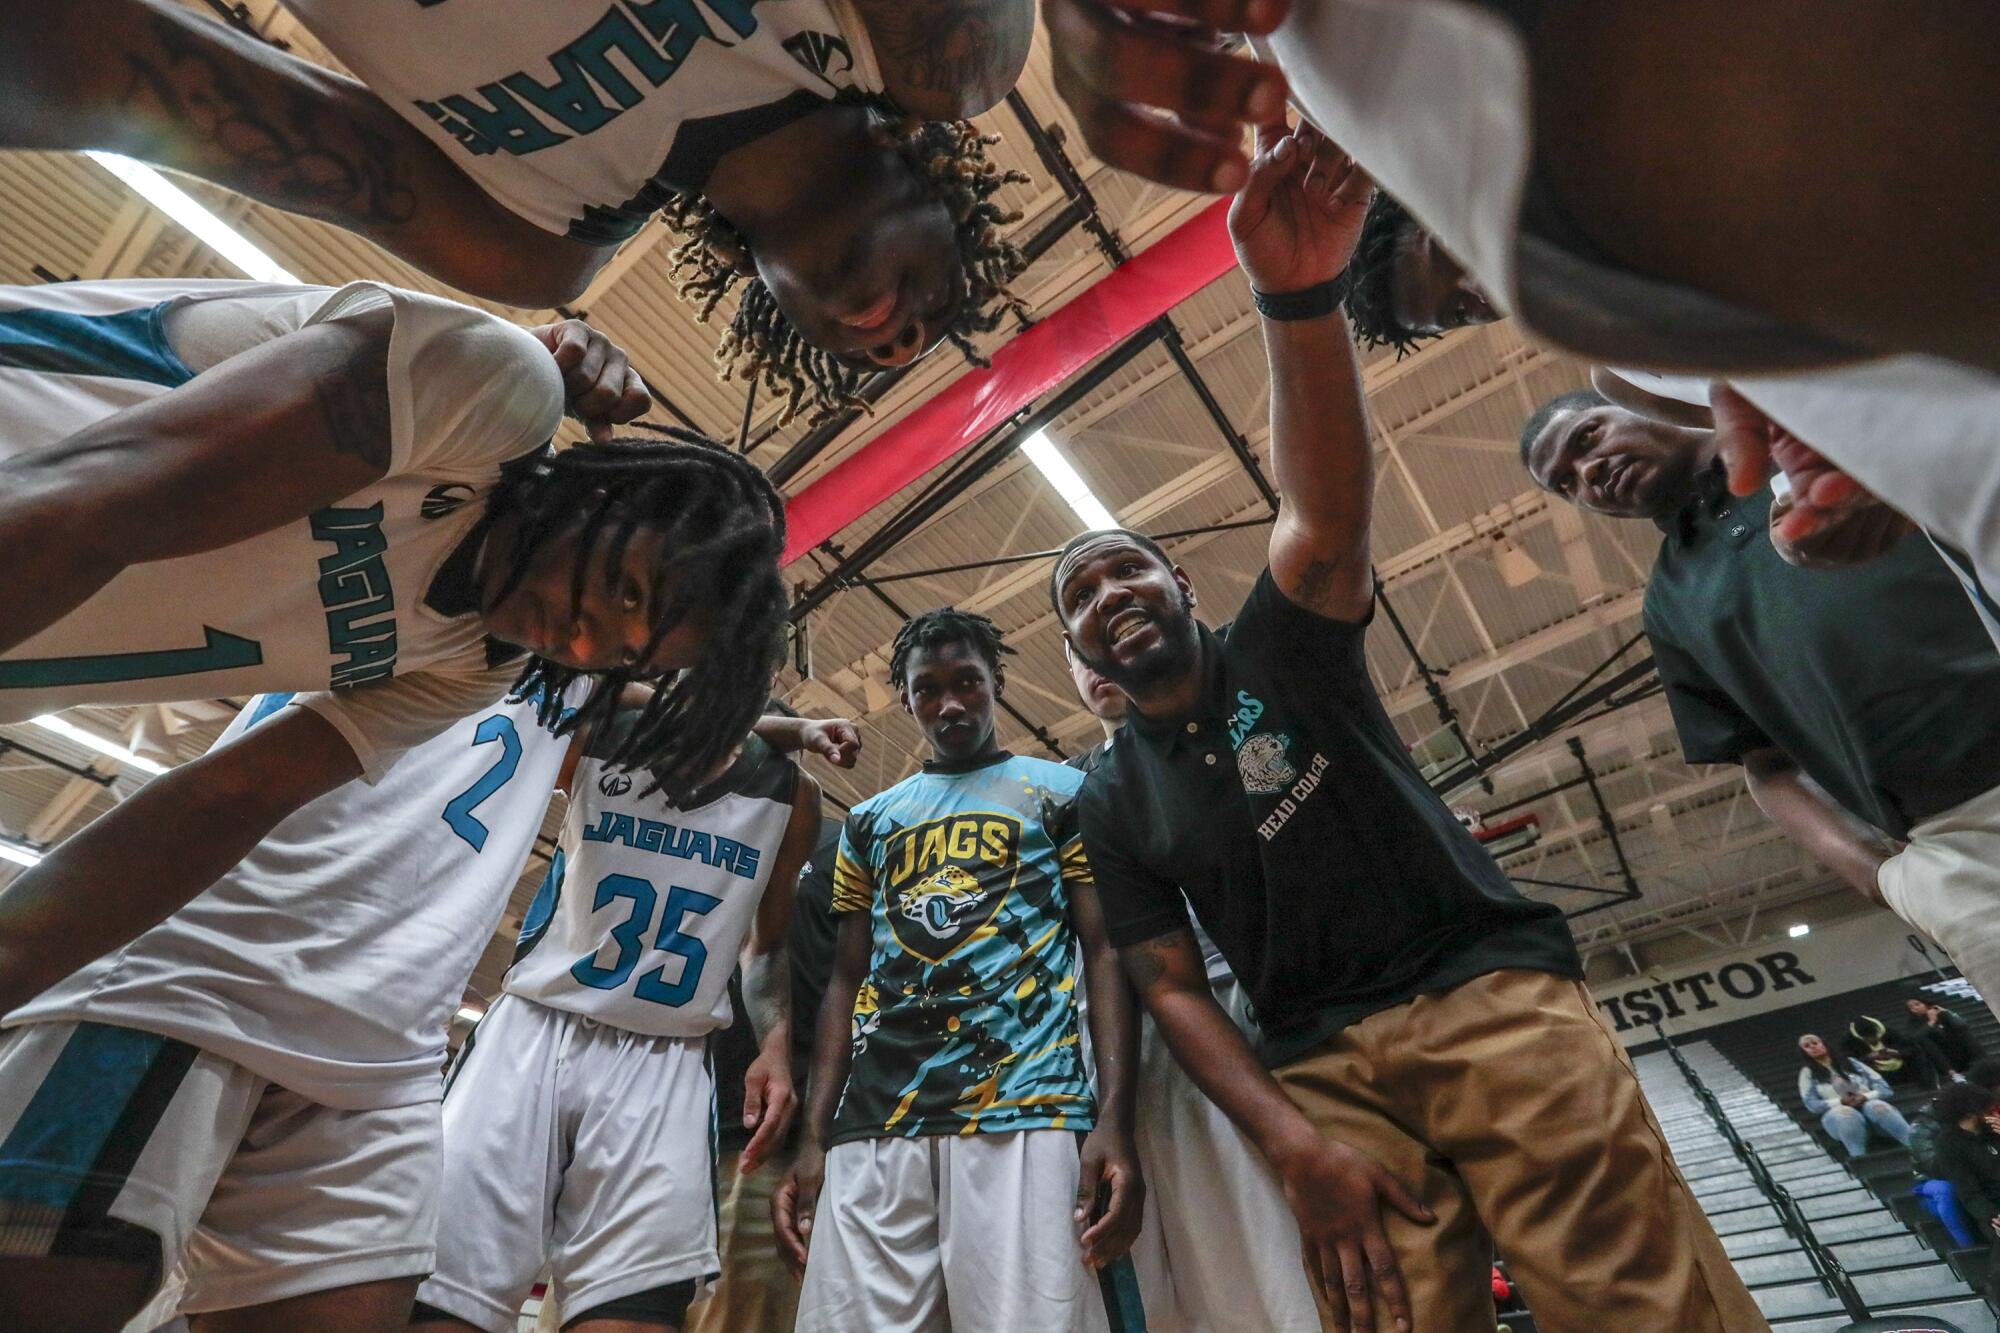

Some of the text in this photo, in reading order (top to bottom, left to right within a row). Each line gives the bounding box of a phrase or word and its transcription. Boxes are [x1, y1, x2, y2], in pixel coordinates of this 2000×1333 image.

[0, 624, 263, 690] 1
[441, 712, 523, 854] 2
[1257, 752, 1331, 842] HEAD COACH
[582, 810, 761, 880] JAGUARS
[889, 819, 1010, 888] JAGS
[570, 872, 724, 1008] 35
[1595, 951, 1817, 1033] ISITOR
